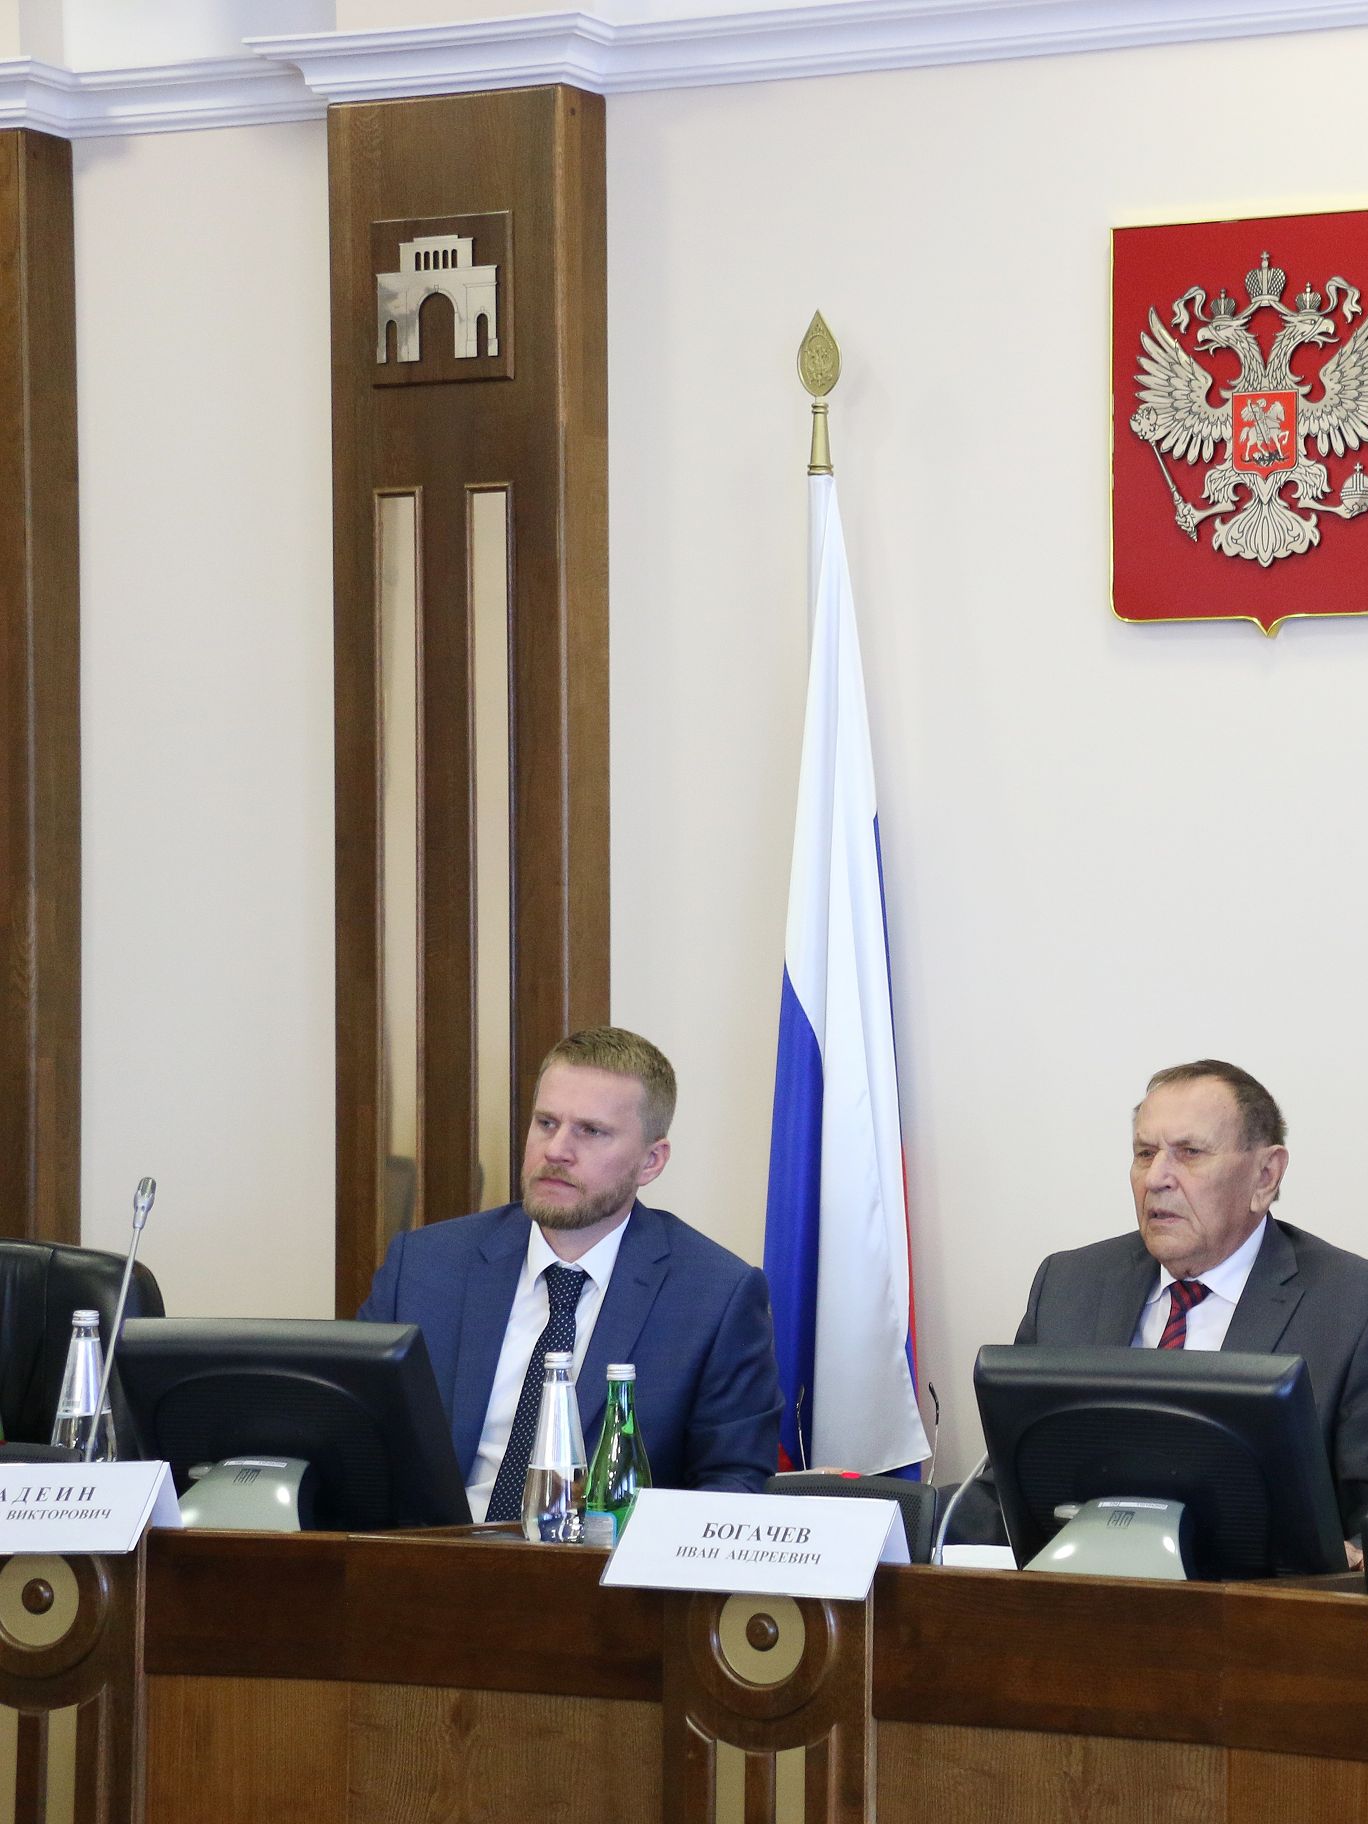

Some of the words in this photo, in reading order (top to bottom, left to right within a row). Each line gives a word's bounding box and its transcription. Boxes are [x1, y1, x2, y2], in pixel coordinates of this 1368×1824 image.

[6, 1509, 112, 1521] ВИКТОРОВИЧ
[701, 1522, 812, 1545] БОГАЧЕВ
[675, 1545, 720, 1560] ИВАН
[725, 1549, 822, 1565] АНДРЕЕВИЧ
